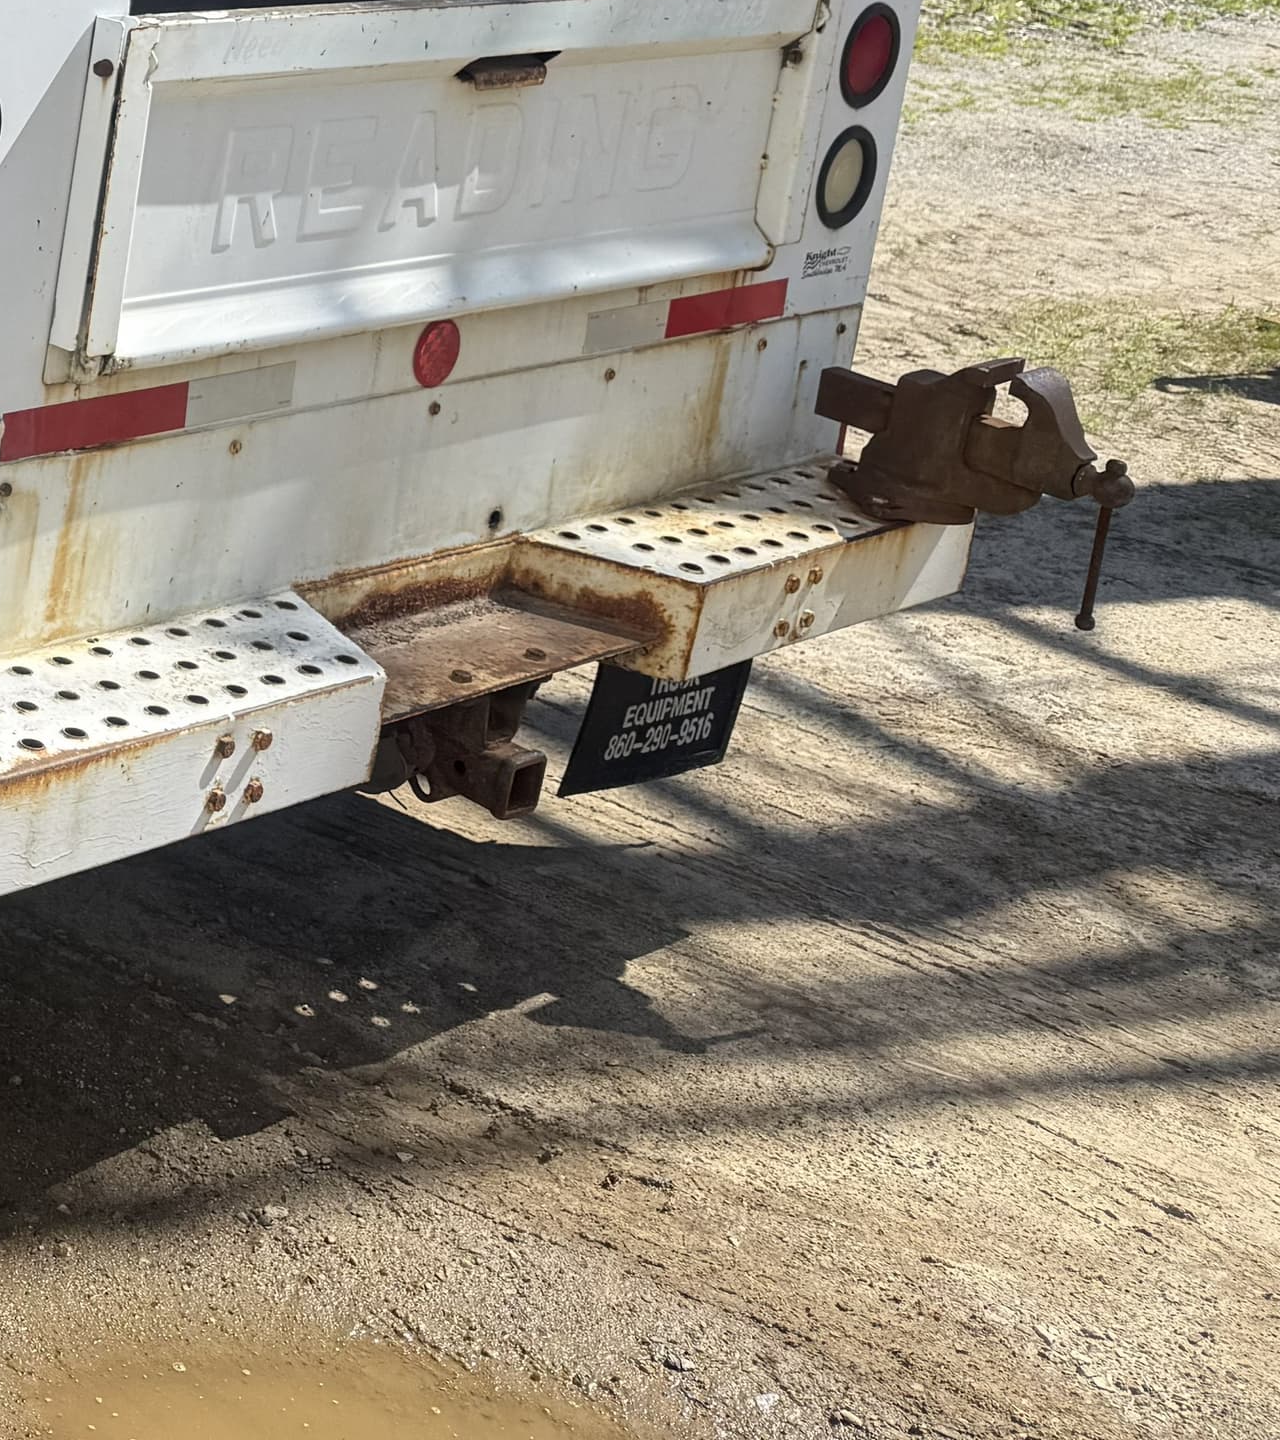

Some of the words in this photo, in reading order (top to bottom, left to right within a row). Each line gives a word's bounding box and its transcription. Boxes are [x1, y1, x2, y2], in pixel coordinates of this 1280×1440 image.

[210, 84, 703, 254] READING
[623, 686, 716, 729] EQUIPMENT
[604, 712, 714, 761] 860-290-9516
